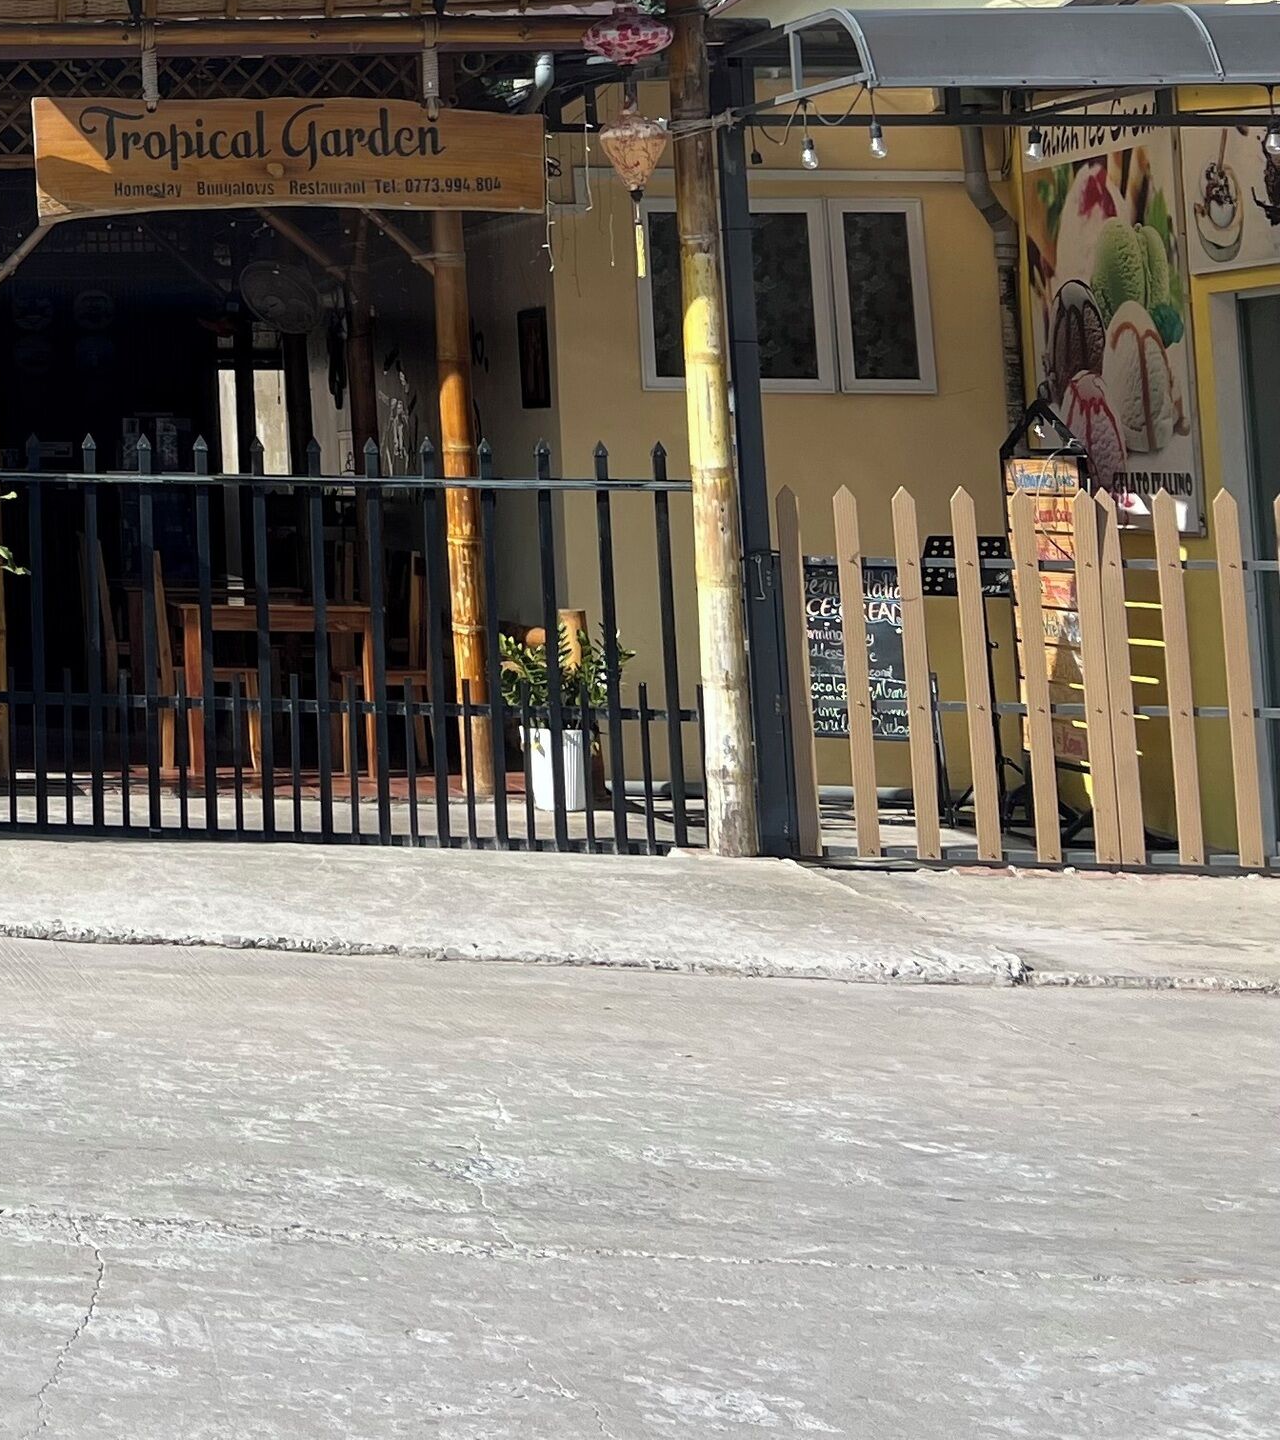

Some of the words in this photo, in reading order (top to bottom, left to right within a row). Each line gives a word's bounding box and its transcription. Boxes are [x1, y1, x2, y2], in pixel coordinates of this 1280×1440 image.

[79, 106, 272, 171] Tropical
[281, 103, 446, 171] Garden
[113, 182, 182, 198] Homestay
[197, 181, 275, 197] Bungalows
[290, 179, 366, 195] Restaurant
[404, 176, 502, 193] 0773.994.804
[1113, 471, 1150, 497] GELATO
[1150, 471, 1193, 497] ITALINO
